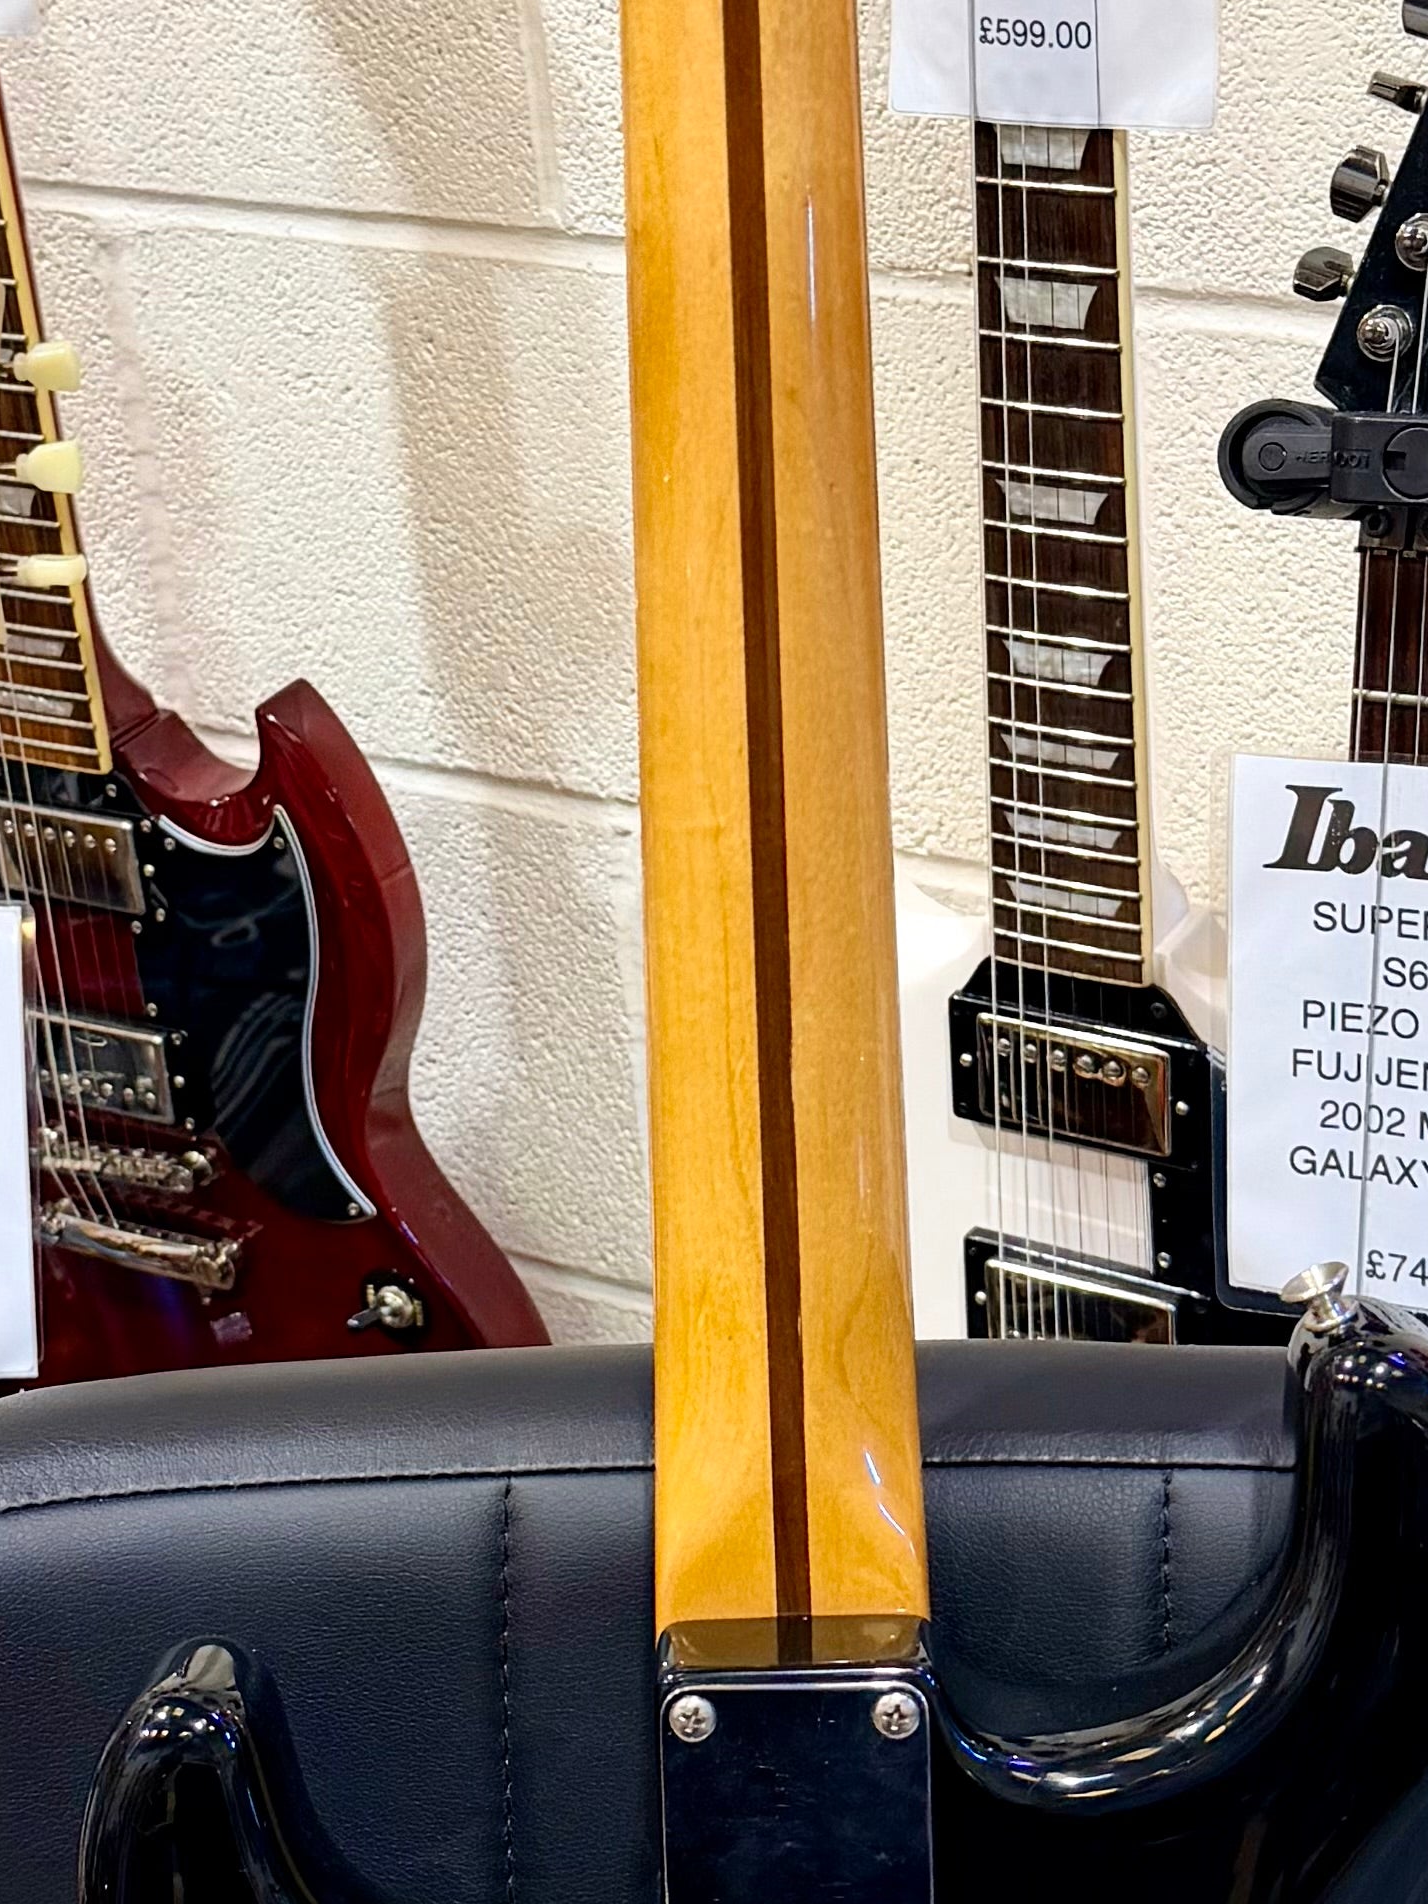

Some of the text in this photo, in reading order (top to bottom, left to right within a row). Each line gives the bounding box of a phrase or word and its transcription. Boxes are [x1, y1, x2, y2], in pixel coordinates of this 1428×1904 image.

[978, 17, 1093, 50] £599.00
[1302, 1000, 1419, 1039] PIEZO
[1319, 1101, 1406, 1138] 2002
